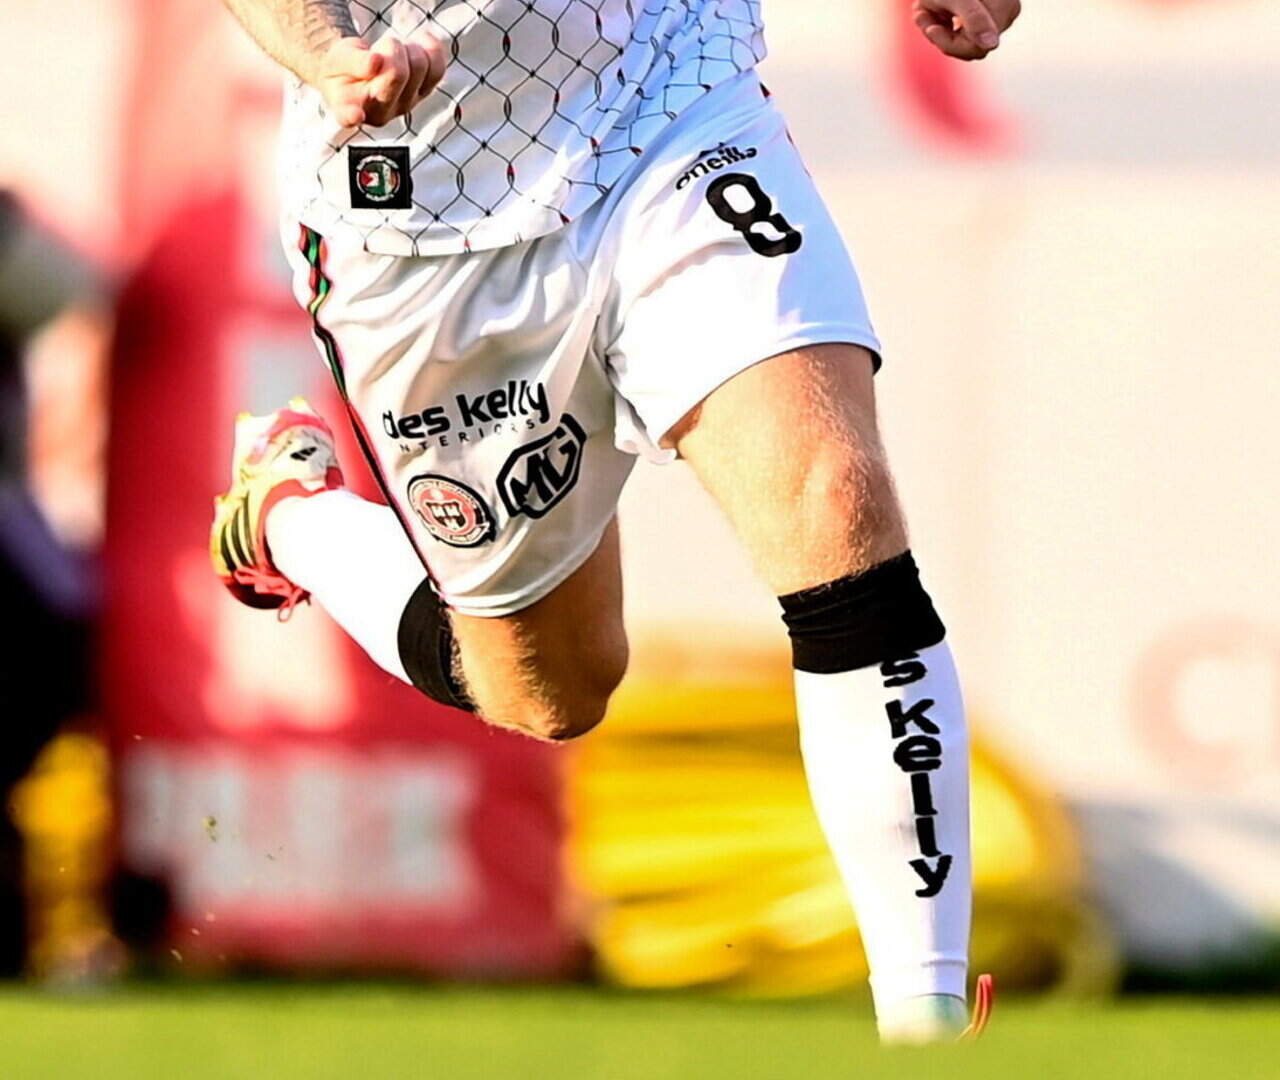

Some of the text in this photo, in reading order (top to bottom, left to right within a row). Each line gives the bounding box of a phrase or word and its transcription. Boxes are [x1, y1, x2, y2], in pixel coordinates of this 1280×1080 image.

[706, 173, 802, 257] 8
[456, 380, 550, 424] kelly
[504, 430, 581, 510] MG
